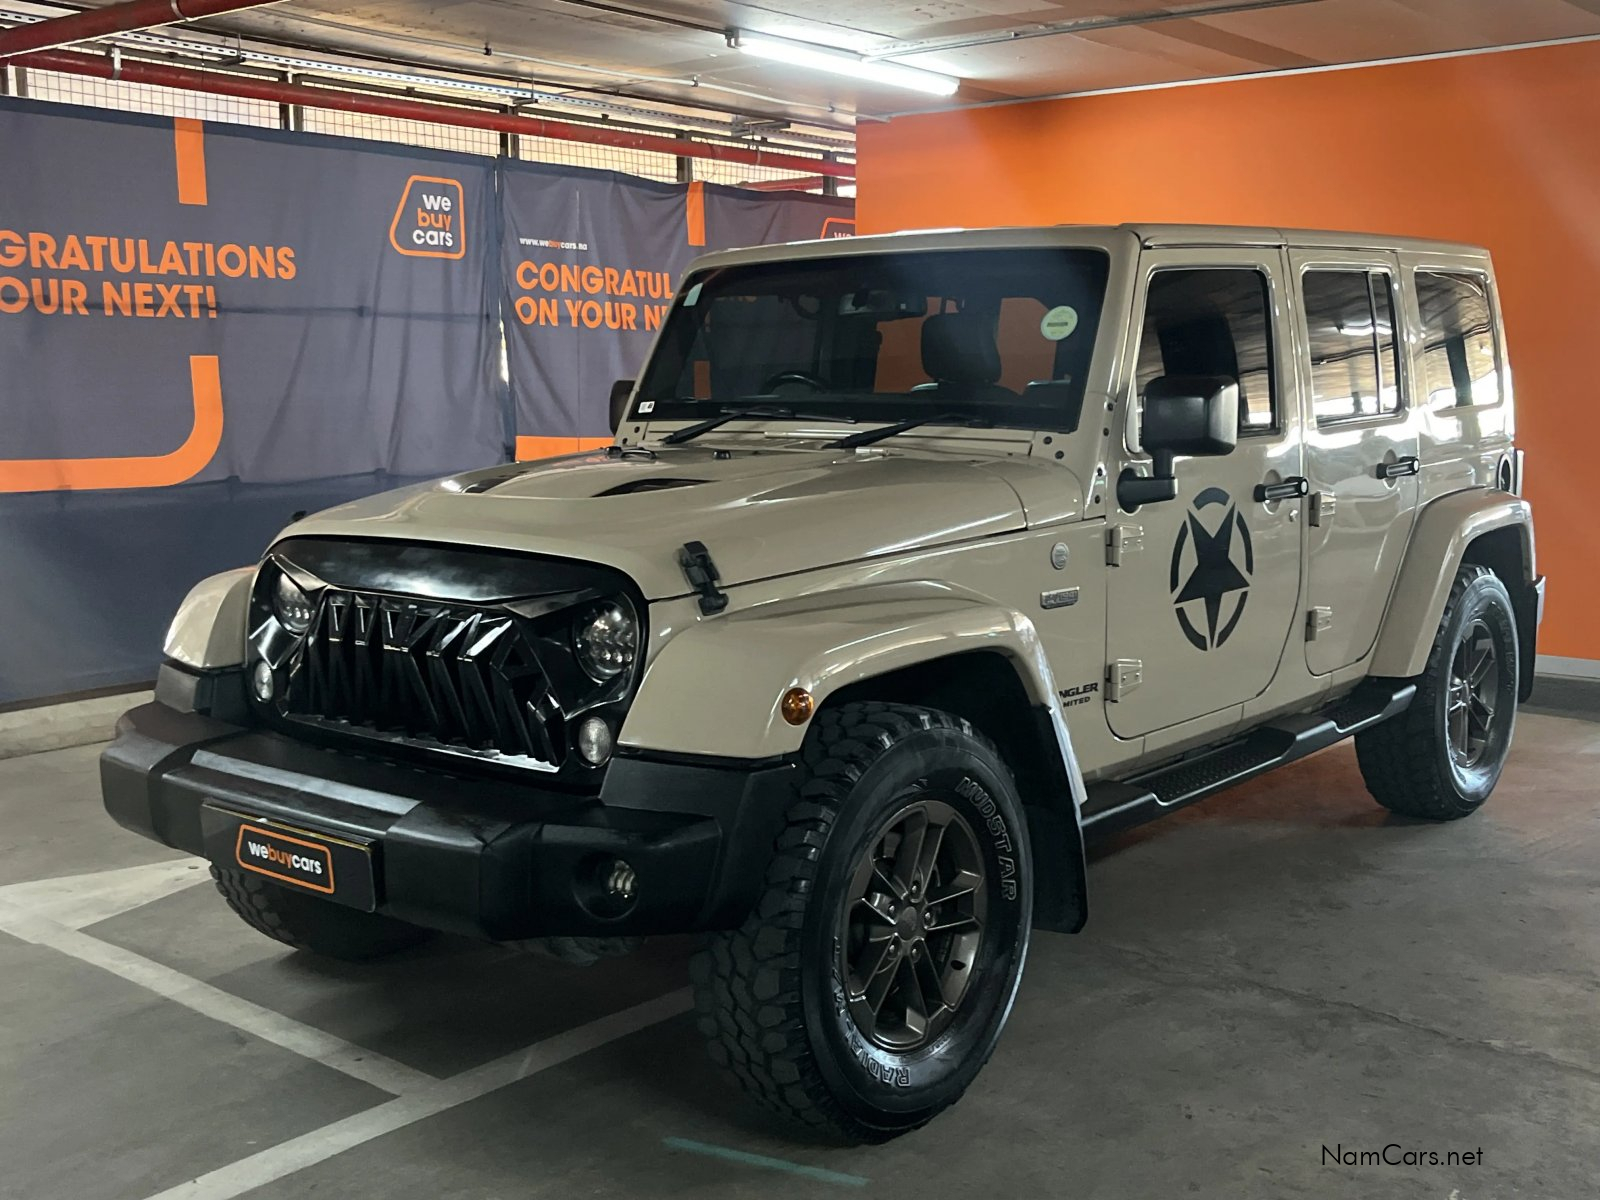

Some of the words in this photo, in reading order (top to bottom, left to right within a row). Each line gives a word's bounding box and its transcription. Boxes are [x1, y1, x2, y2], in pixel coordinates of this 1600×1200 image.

[417, 208, 452, 231] buy
[422, 194, 452, 211] we
[0, 230, 297, 280] GRATULATIONS
[412, 229, 453, 247] cars
[0, 276, 89, 315] OUR
[102, 281, 217, 318] NEXT!
[515, 296, 558, 327] ON
[565, 300, 637, 331] YOUR
[954, 776, 1017, 902] MUDSTAR
[247, 841, 323, 875] webuycars
